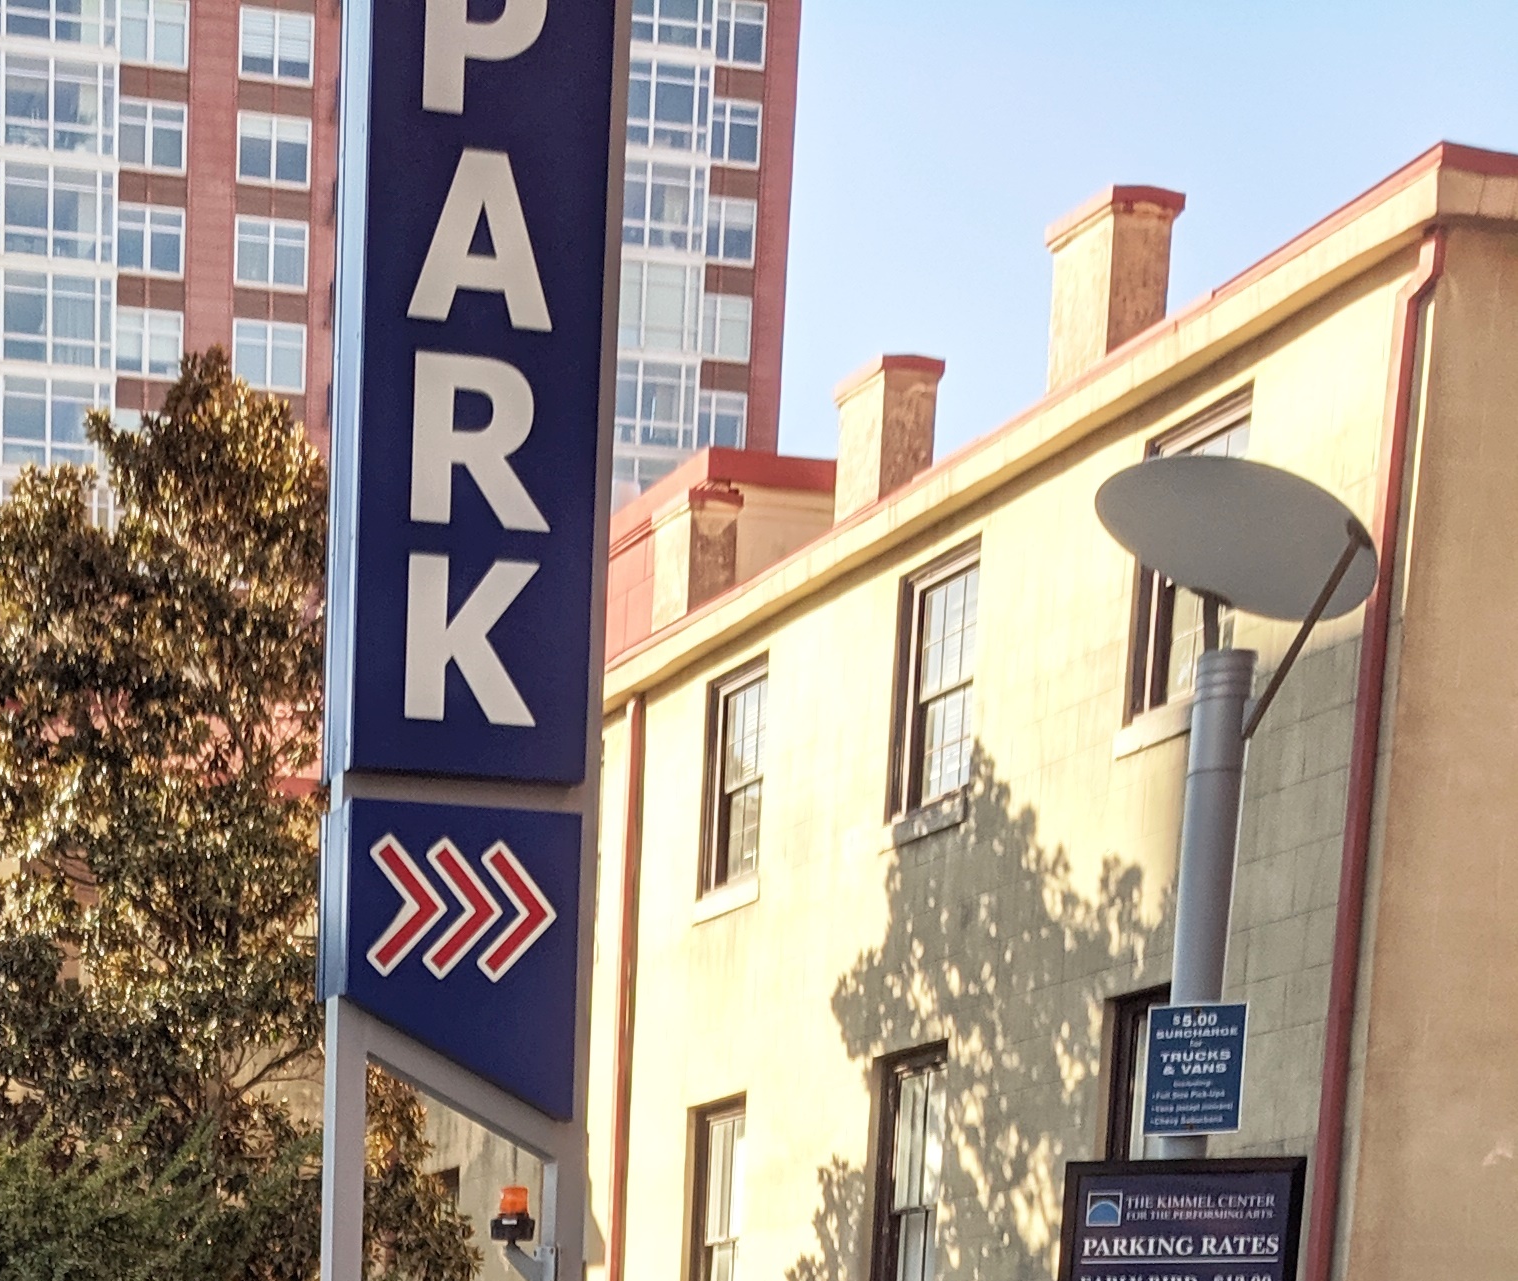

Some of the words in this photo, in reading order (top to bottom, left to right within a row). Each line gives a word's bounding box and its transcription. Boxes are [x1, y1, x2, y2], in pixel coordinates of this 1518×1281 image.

[404, 0, 552, 728] PARK
[1172, 1012, 1218, 1027] $5.00
[1156, 1026, 1238, 1039] SURCHARGE
[1160, 1050, 1231, 1063] TRUCKS
[1162, 1064, 1175, 1075] &
[1181, 1062, 1227, 1075] VANS
[1126, 1195, 1153, 1209] THE
[1157, 1194, 1215, 1209] KIMMEL
[1218, 1193, 1275, 1208] CENTER
[1172, 1209, 1244, 1220] PERFORMING
[1083, 1235, 1194, 1256] PARKING
[1200, 1234, 1279, 1256] RATES
